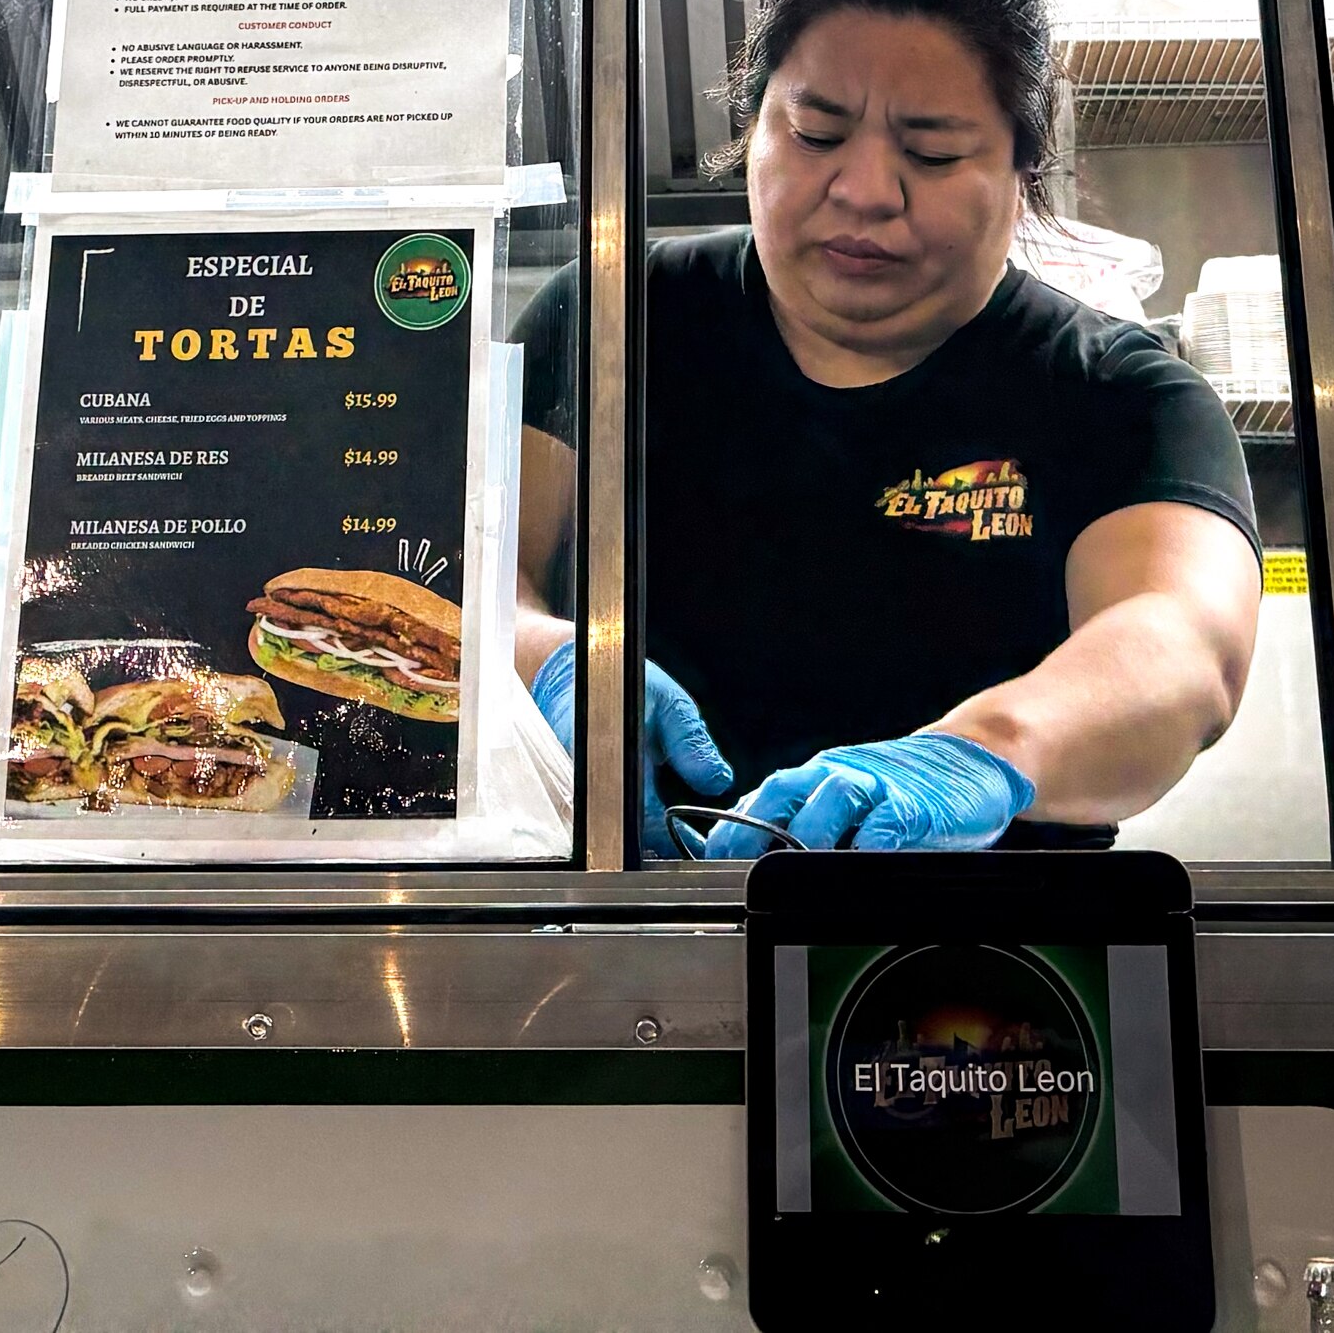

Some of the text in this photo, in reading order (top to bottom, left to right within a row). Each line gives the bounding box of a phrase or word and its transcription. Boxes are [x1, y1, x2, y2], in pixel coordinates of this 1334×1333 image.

[238, 21, 332, 30] CUSTOMER CONDUCT
[121, 56, 153, 64] PLEASE
[315, 95, 350, 103] ORDERS
[187, 255, 312, 277] ESPECIAL
[390, 273, 453, 293] EL TAQUITO
[429, 285, 459, 302] LEON
[229, 296, 265, 316] DE
[135, 327, 354, 360] TORTAS
[80, 391, 397, 410] CUBANA $15.99
[76, 448, 398, 467] MILANESA DE RES $14.99
[137, 472, 183, 481] SANDWICH
[884, 485, 1024, 519] EL TAQUITO
[70, 515, 396, 534] MILANESA DE POLLO $14.99
[971, 509, 1033, 541] LEON
[71, 542, 109, 550] BREADED
[149, 541, 194, 549] SANDWICH
[855, 1063, 1095, 1098] El Taquito Leon
